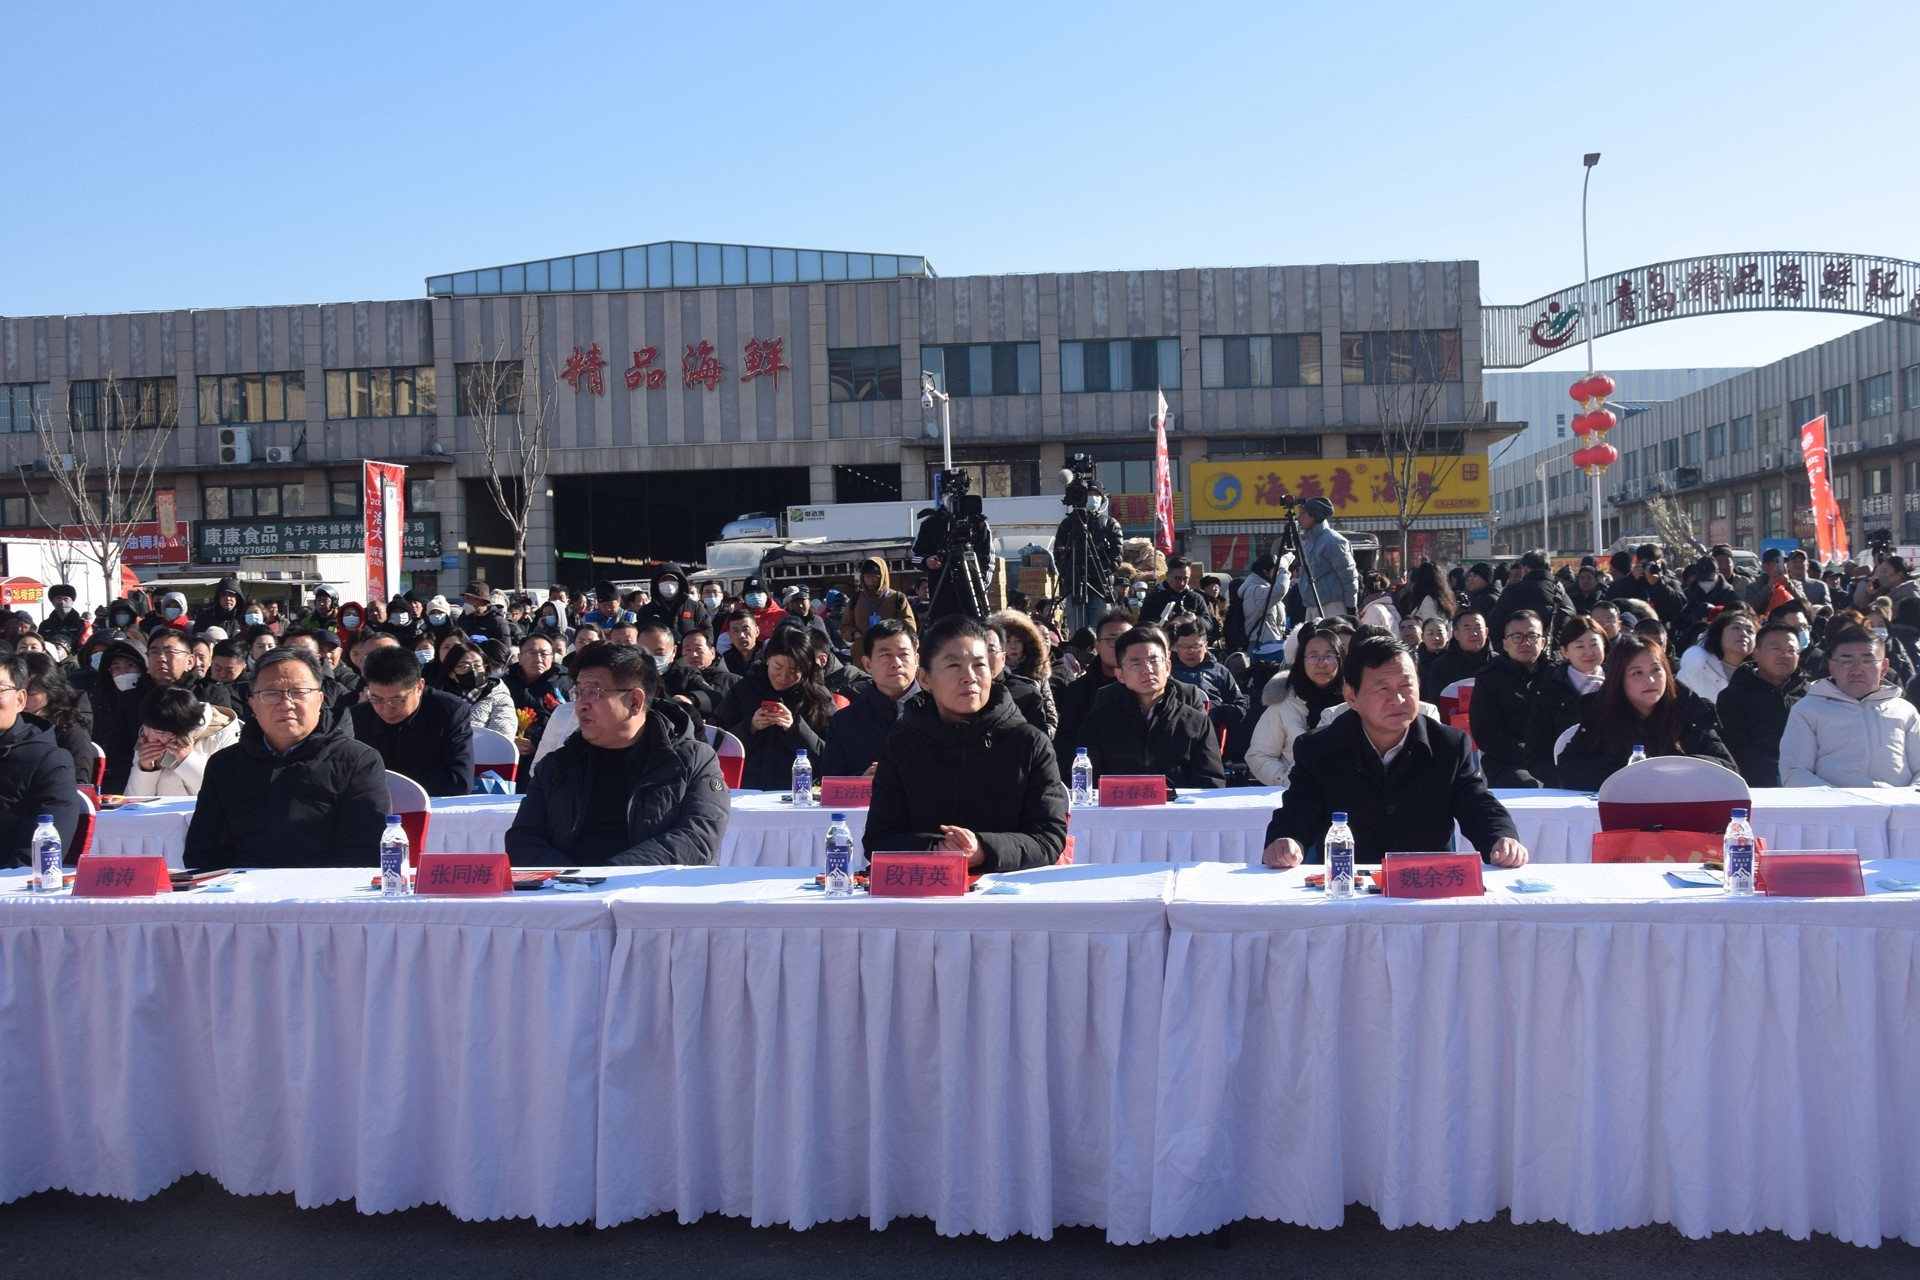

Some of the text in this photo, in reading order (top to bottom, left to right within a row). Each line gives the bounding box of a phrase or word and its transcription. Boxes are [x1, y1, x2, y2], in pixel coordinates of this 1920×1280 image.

[1607, 258, 1920, 322] 青岛精品海鲜配
[561, 335, 790, 397] 精品海鲜
[205, 525, 279, 546] 康康食品
[218, 546, 277, 555] 13589270560
[13, 588, 42, 601] 冰糖葫芦
[830, 784, 873, 800] 王法民
[1109, 784, 1157, 800] 石春磊
[95, 866, 136, 888] 薄涛
[430, 864, 493, 885] 张同海
[884, 864, 949, 887] 段青英
[1399, 865, 1465, 889] 魏余秀
